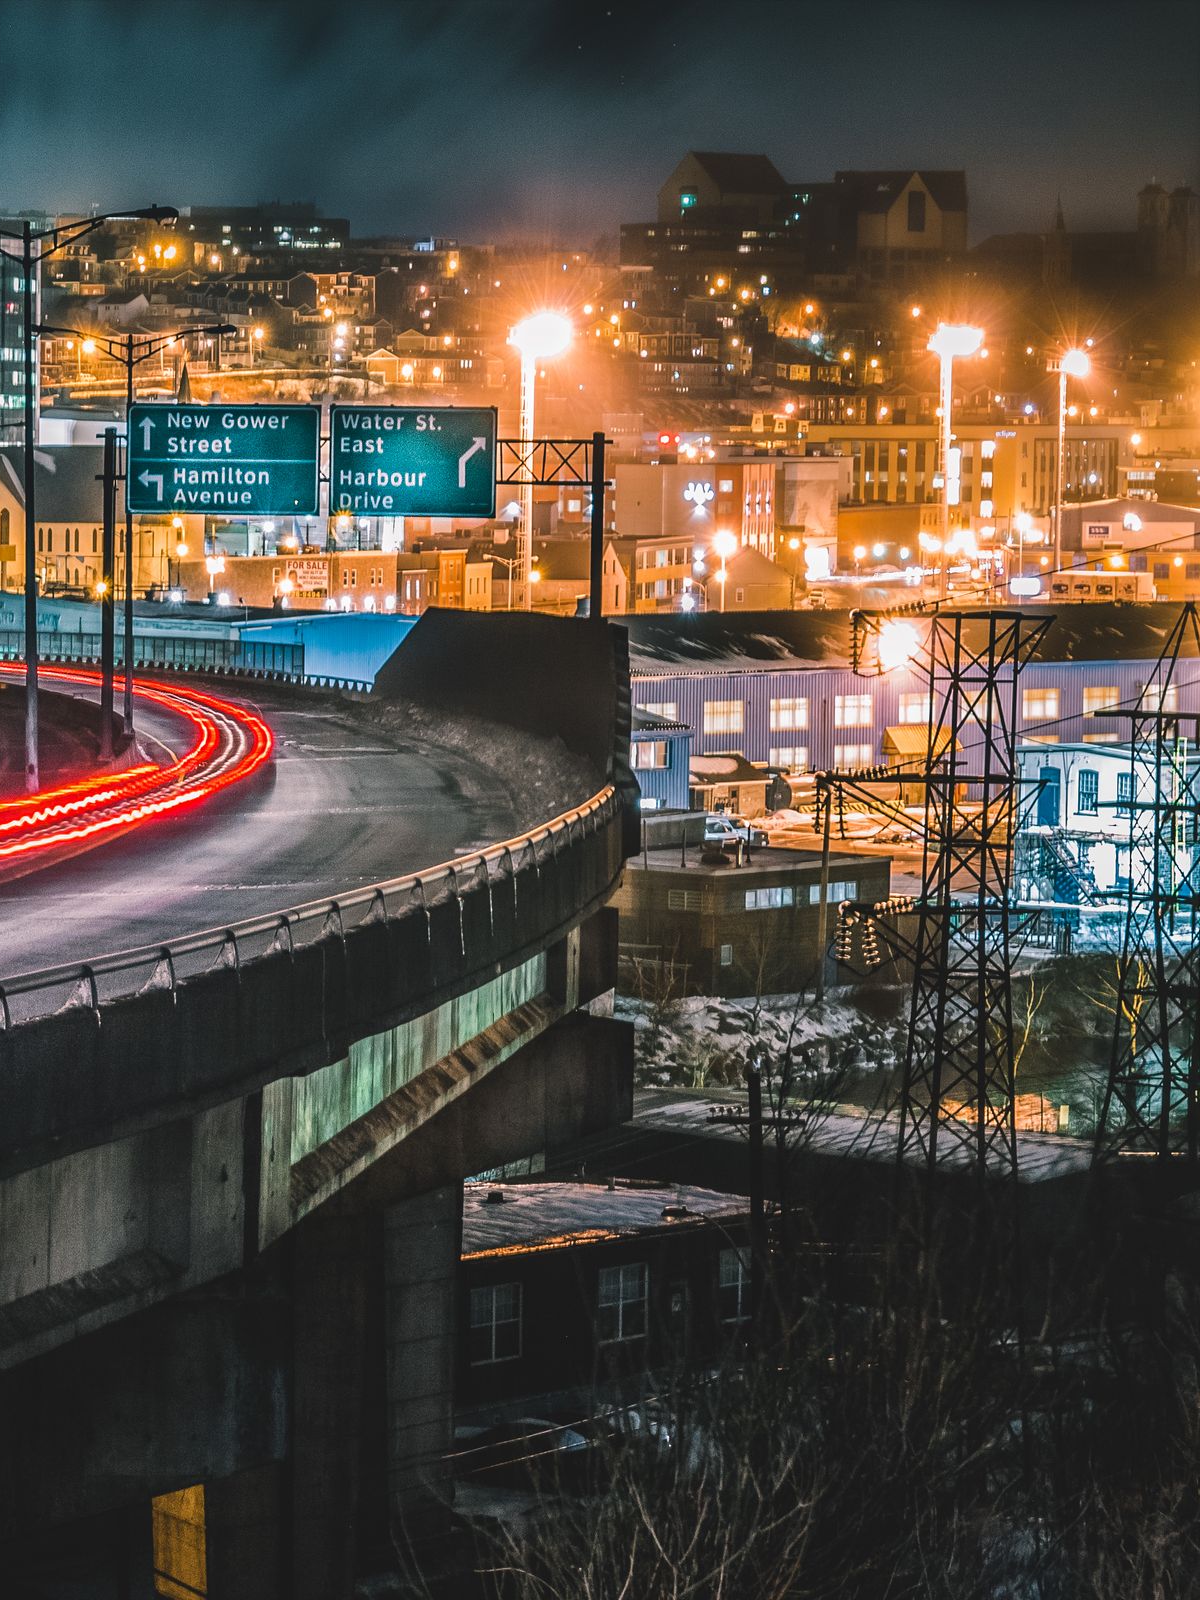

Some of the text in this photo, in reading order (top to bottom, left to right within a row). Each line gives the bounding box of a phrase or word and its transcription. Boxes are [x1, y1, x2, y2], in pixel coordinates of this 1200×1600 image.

[167, 412, 289, 429] New Gower
[341, 413, 442, 431] Water St.
[167, 436, 232, 453] Street
[340, 436, 384, 454] East
[173, 466, 270, 485] Hamilton
[339, 468, 427, 487] Harbour
[173, 488, 252, 504] Avenue
[339, 491, 394, 509] Drive
[287, 561, 327, 570] FOR SALE
